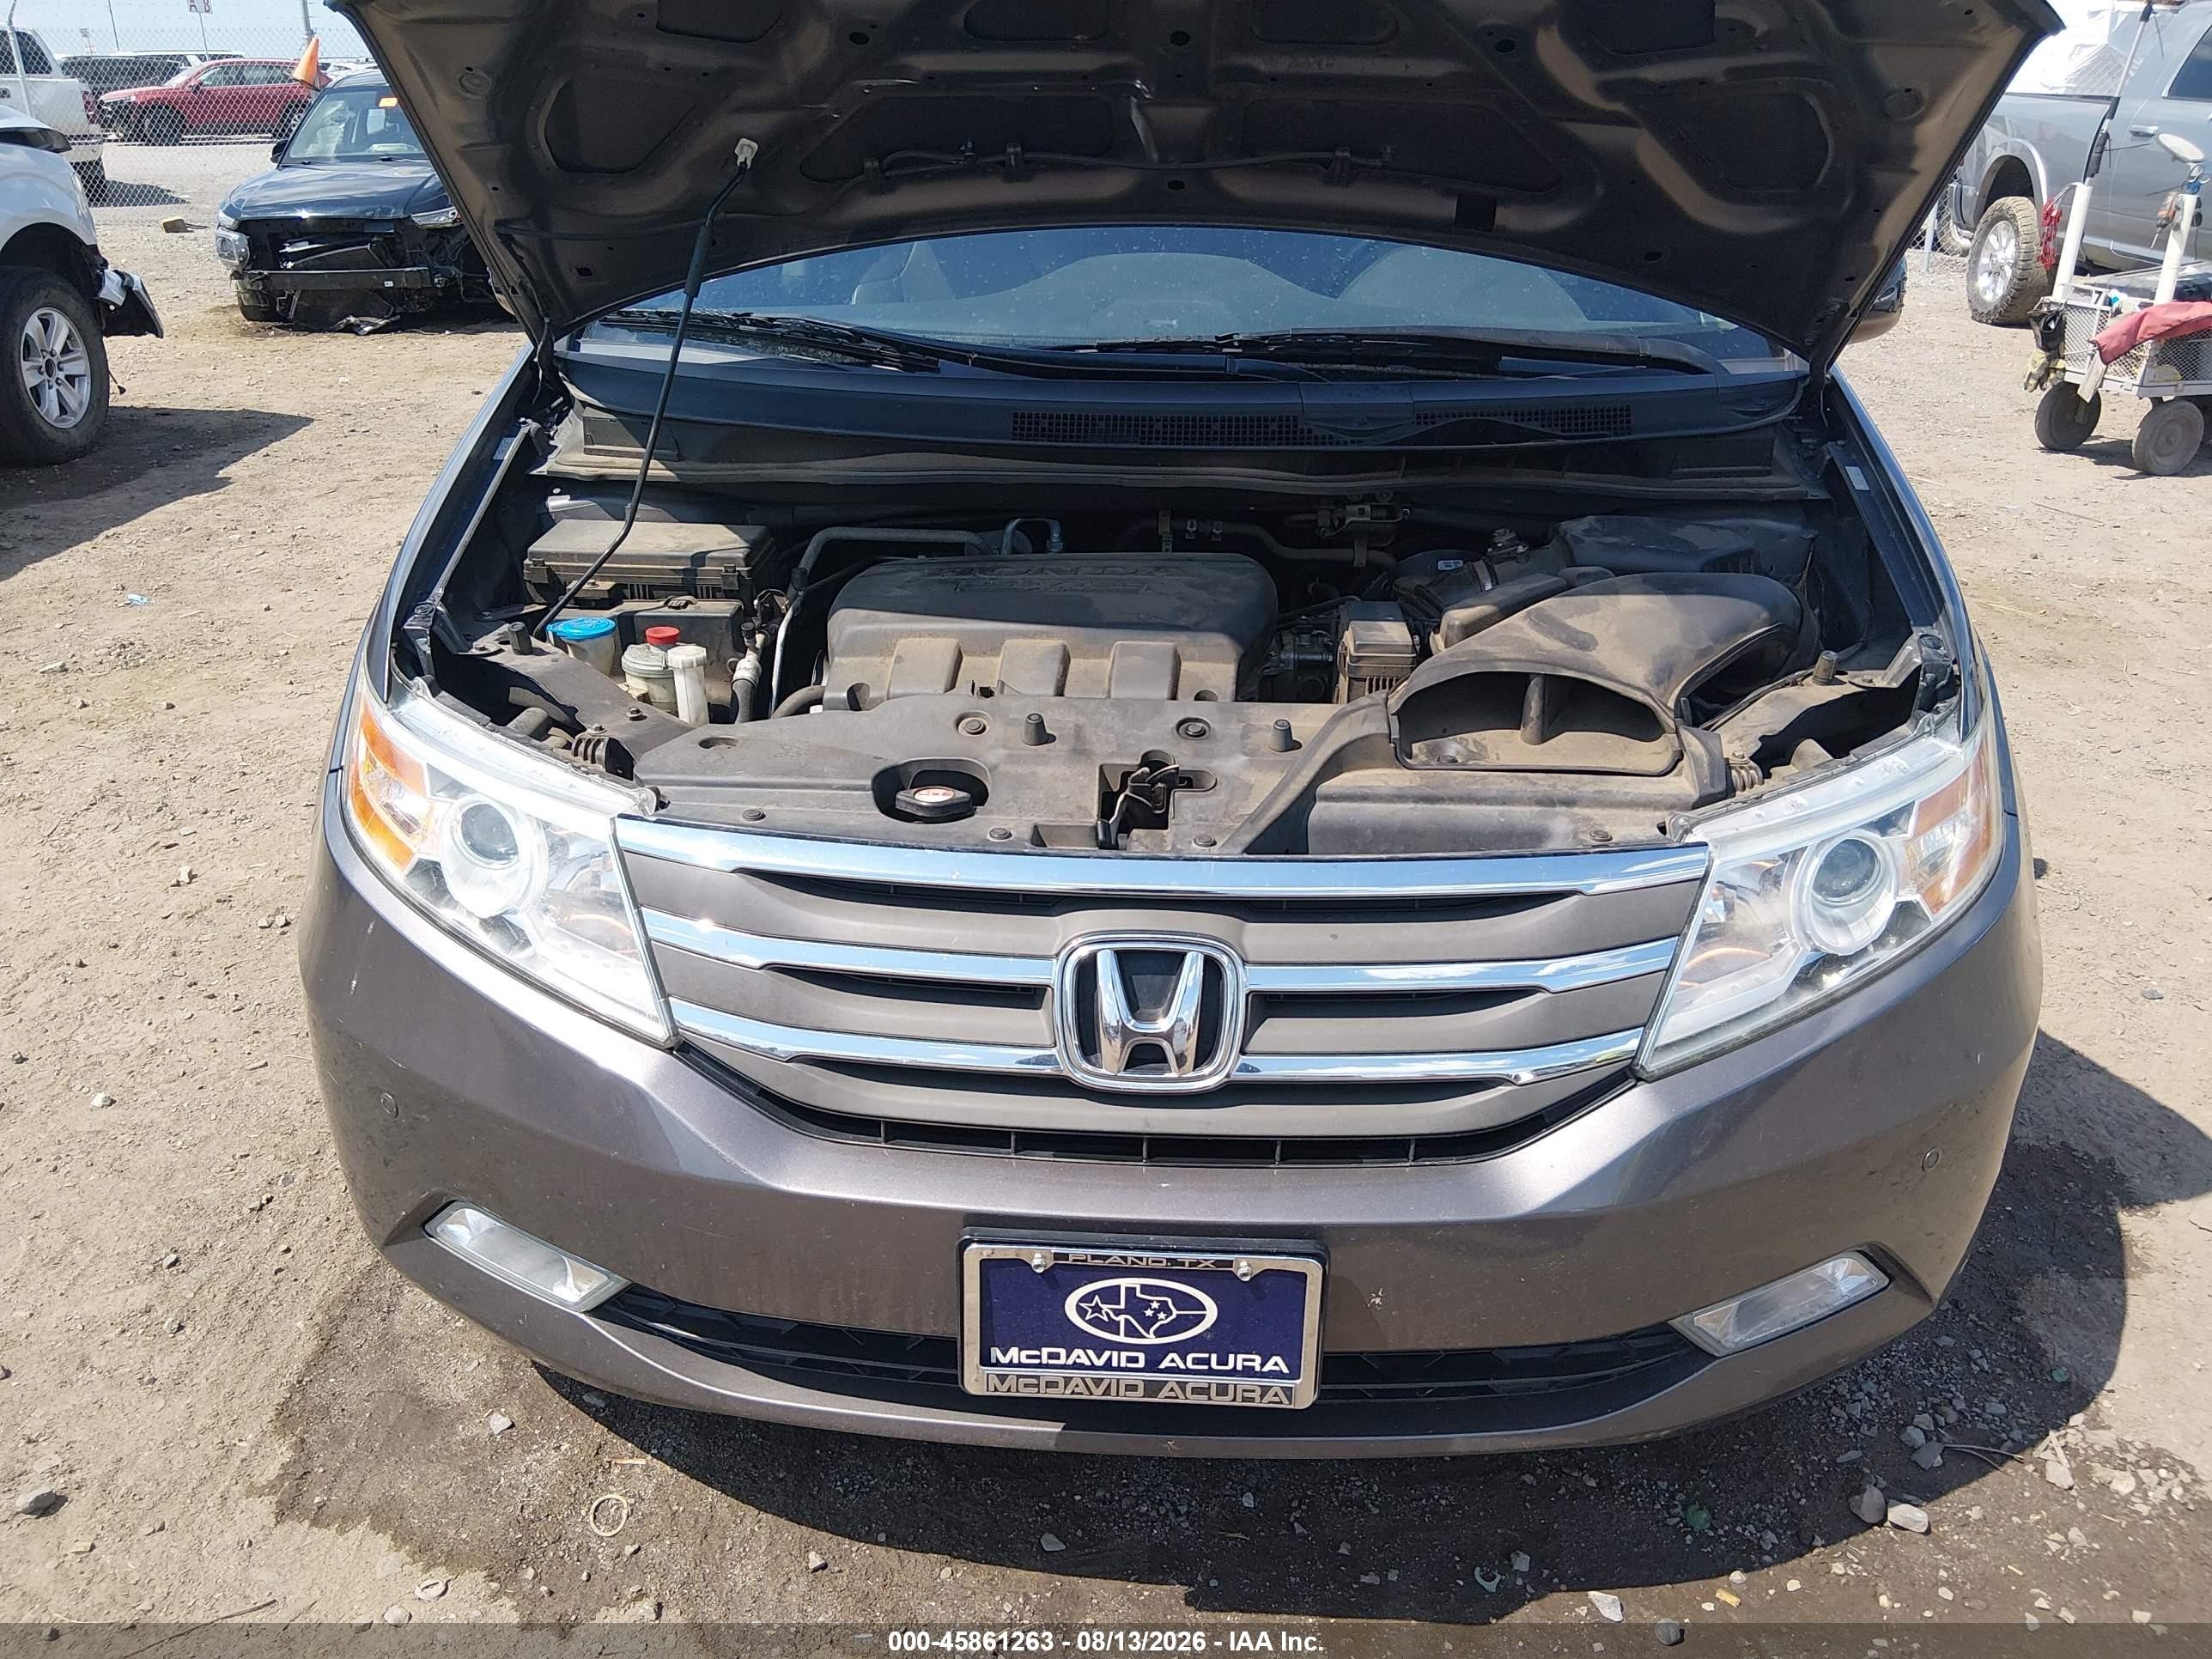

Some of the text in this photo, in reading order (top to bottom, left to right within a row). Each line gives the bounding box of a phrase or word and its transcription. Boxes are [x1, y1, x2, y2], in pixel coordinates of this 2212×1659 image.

[1177, 1258, 1217, 1268] TX
[990, 1346, 1290, 1373] McDAVID ACURA
[988, 1374, 1290, 1405] McDAVID ACURA
